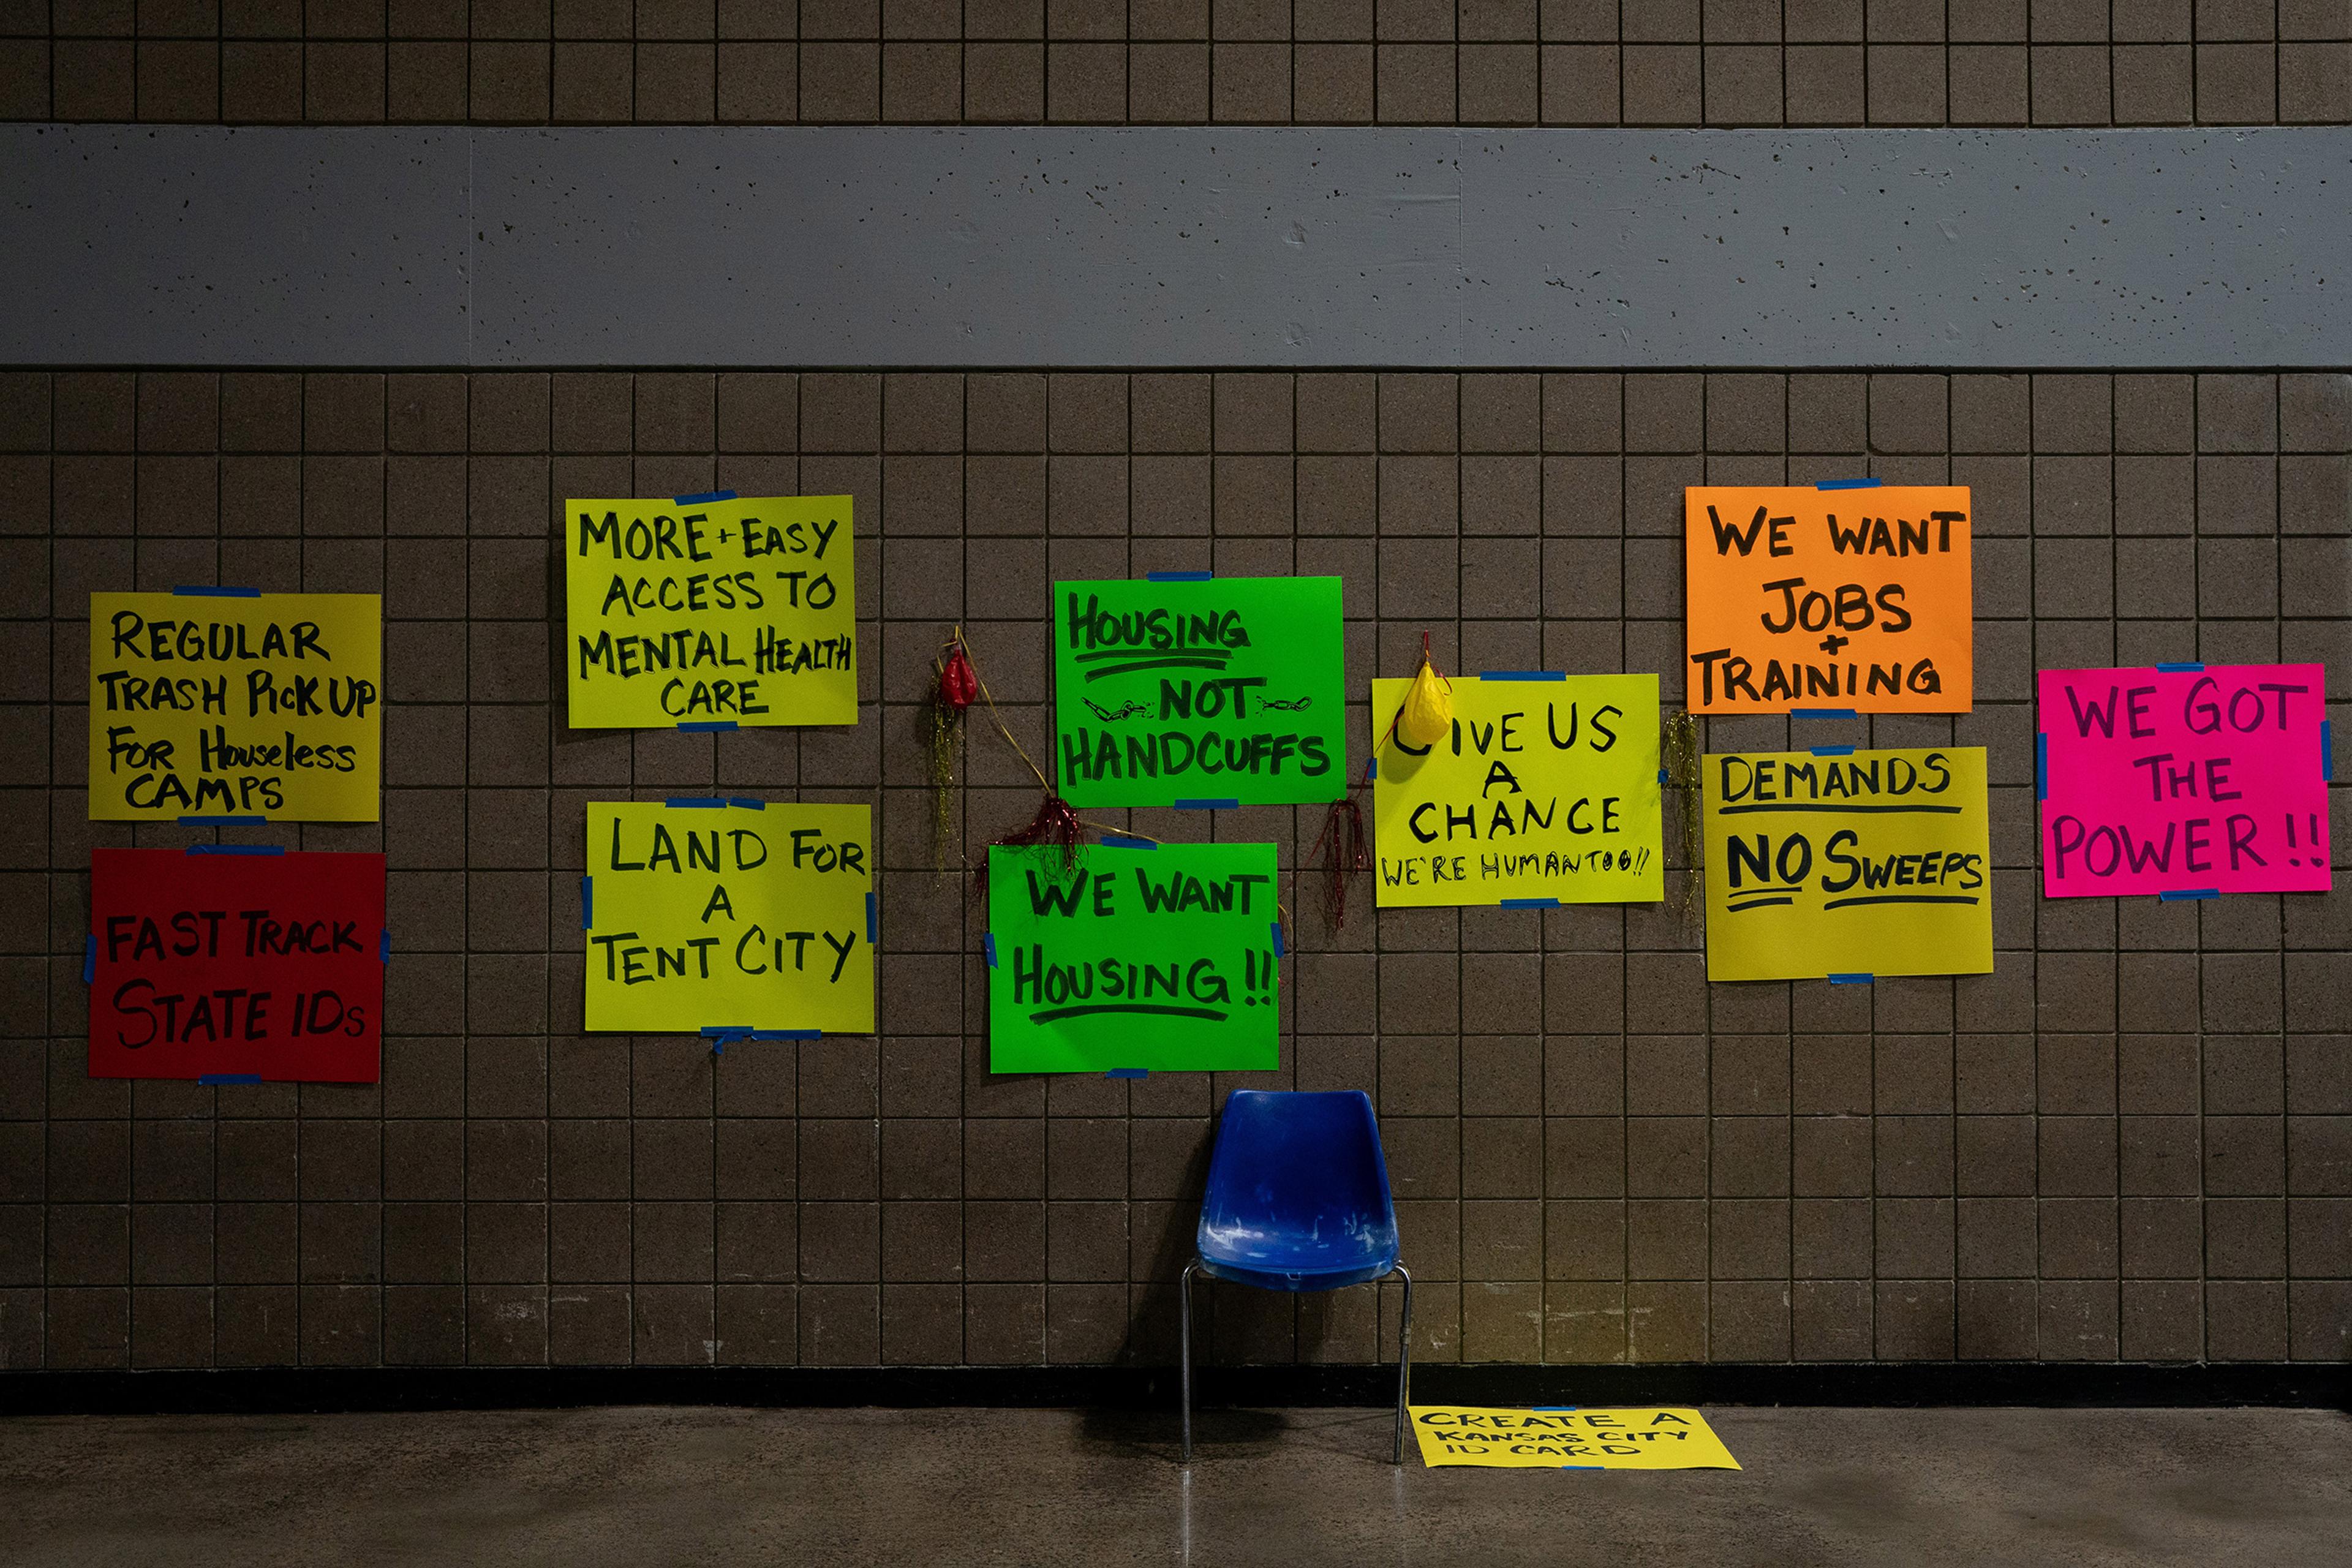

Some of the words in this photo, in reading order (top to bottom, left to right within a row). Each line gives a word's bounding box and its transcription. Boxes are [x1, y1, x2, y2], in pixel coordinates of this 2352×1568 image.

[580, 512, 713, 562] MORE
[741, 518, 838, 559] EASY
[1707, 505, 1796, 557] WE
[1827, 511, 1966, 557] WANT
[601, 571, 764, 617] ACCESS
[777, 571, 835, 610] TO
[1761, 578, 1911, 633] JOBS
[111, 611, 330, 662] REGULAR
[1068, 592, 1251, 649] HOUSING
[579, 629, 746, 680] MENTAL
[755, 625, 851, 675] HEALTH
[1691, 649, 1941, 706] TRAINING
[98, 671, 227, 715] TRASH
[330, 676, 376, 718] UP
[662, 677, 769, 717] CARE
[1159, 677, 1267, 720] NOT
[2065, 685, 2157, 739] WE
[2185, 676, 2309, 734] GOT
[107, 726, 174, 774] FOR
[1548, 702, 1623, 752] US
[1063, 728, 1332, 788] HANDCUFFS
[1482, 761, 1522, 799] A
[1721, 753, 1950, 801] DEMANDS
[2133, 753, 2242, 802] THE
[125, 774, 283, 812] CAMPS
[1409, 797, 1619, 843] CHANCE
[611, 817, 767, 873] LAND
[790, 829, 865, 875] FOR
[1381, 855, 1466, 886] WE'RE
[1728, 832, 1812, 888] NO
[1822, 829, 1983, 892] SWEEPS
[702, 884, 734, 924] A
[1026, 867, 1116, 918] WE
[1135, 867, 1271, 916] WANT
[107, 911, 227, 963] FAST
[240, 910, 363, 957] TRACK
[592, 932, 720, 986] TENT
[736, 924, 856, 983] CITY
[113, 978, 271, 1050] STATE
[1420, 1413, 1625, 1428] CREATE
[1651, 1412, 1692, 1425] A
[1434, 1431, 1585, 1442] KANSAS
[1597, 1431, 1687, 1441] CITY
[1446, 1445, 1490, 1453] ID
[1510, 1445, 1642, 1457] CARD
